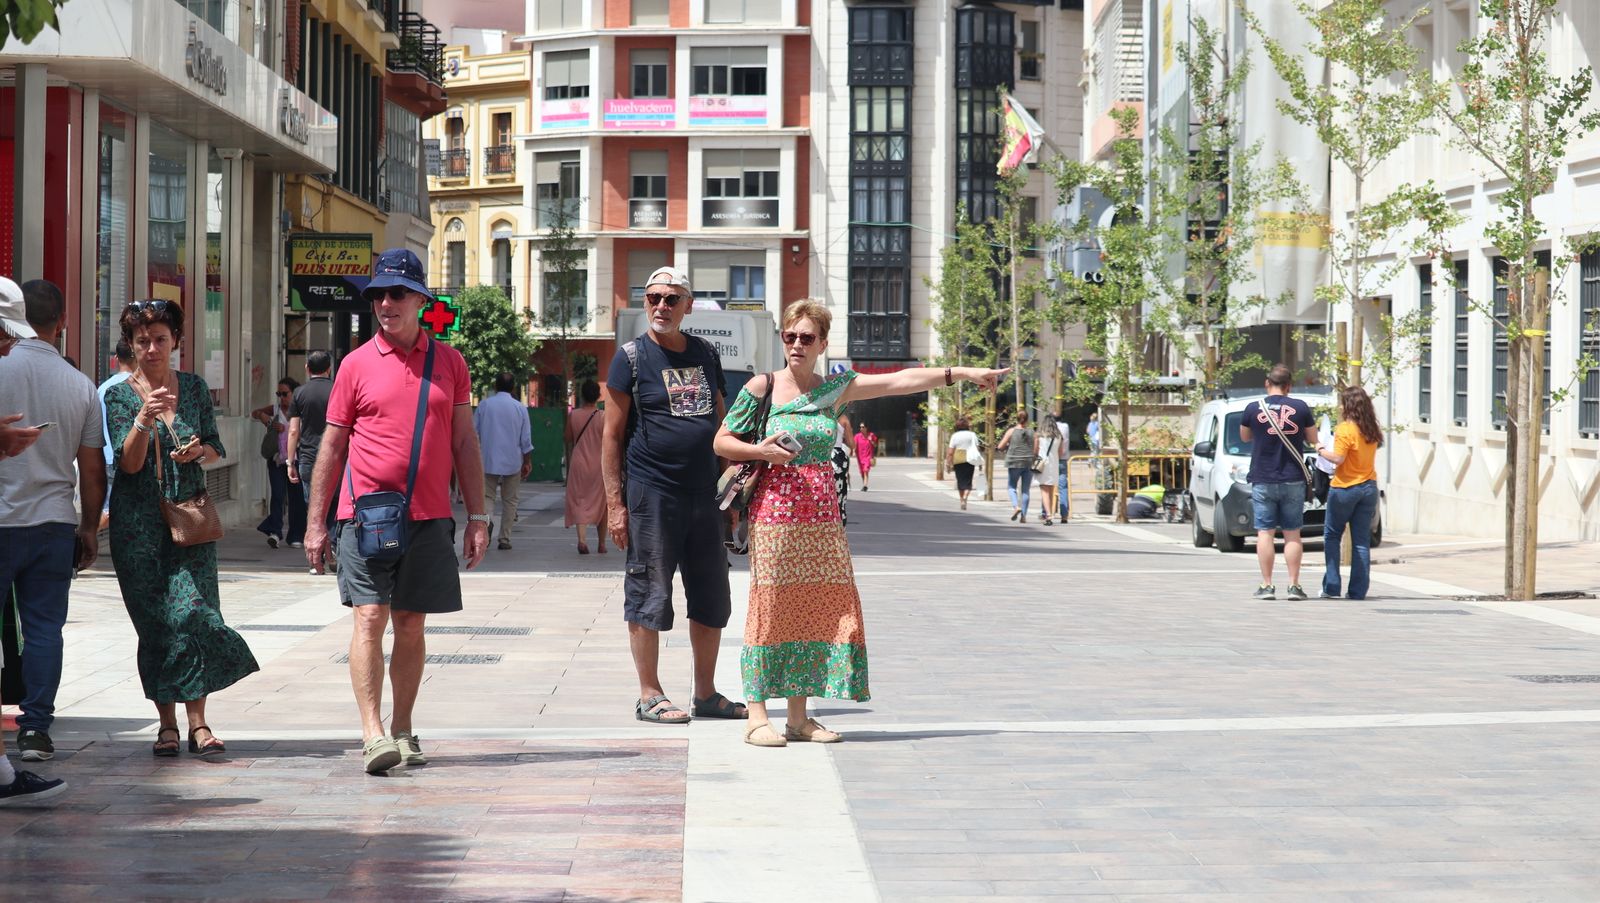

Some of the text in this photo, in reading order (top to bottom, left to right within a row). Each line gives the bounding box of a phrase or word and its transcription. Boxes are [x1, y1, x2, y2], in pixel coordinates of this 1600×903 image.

[610, 102, 672, 113] huelvaderm
[325, 241, 337, 249] DE
[338, 241, 372, 249] JUEGOS
[336, 250, 359, 260] Bar
[294, 263, 369, 275] PLUS ULTRA
[682, 327, 733, 336] danzas
